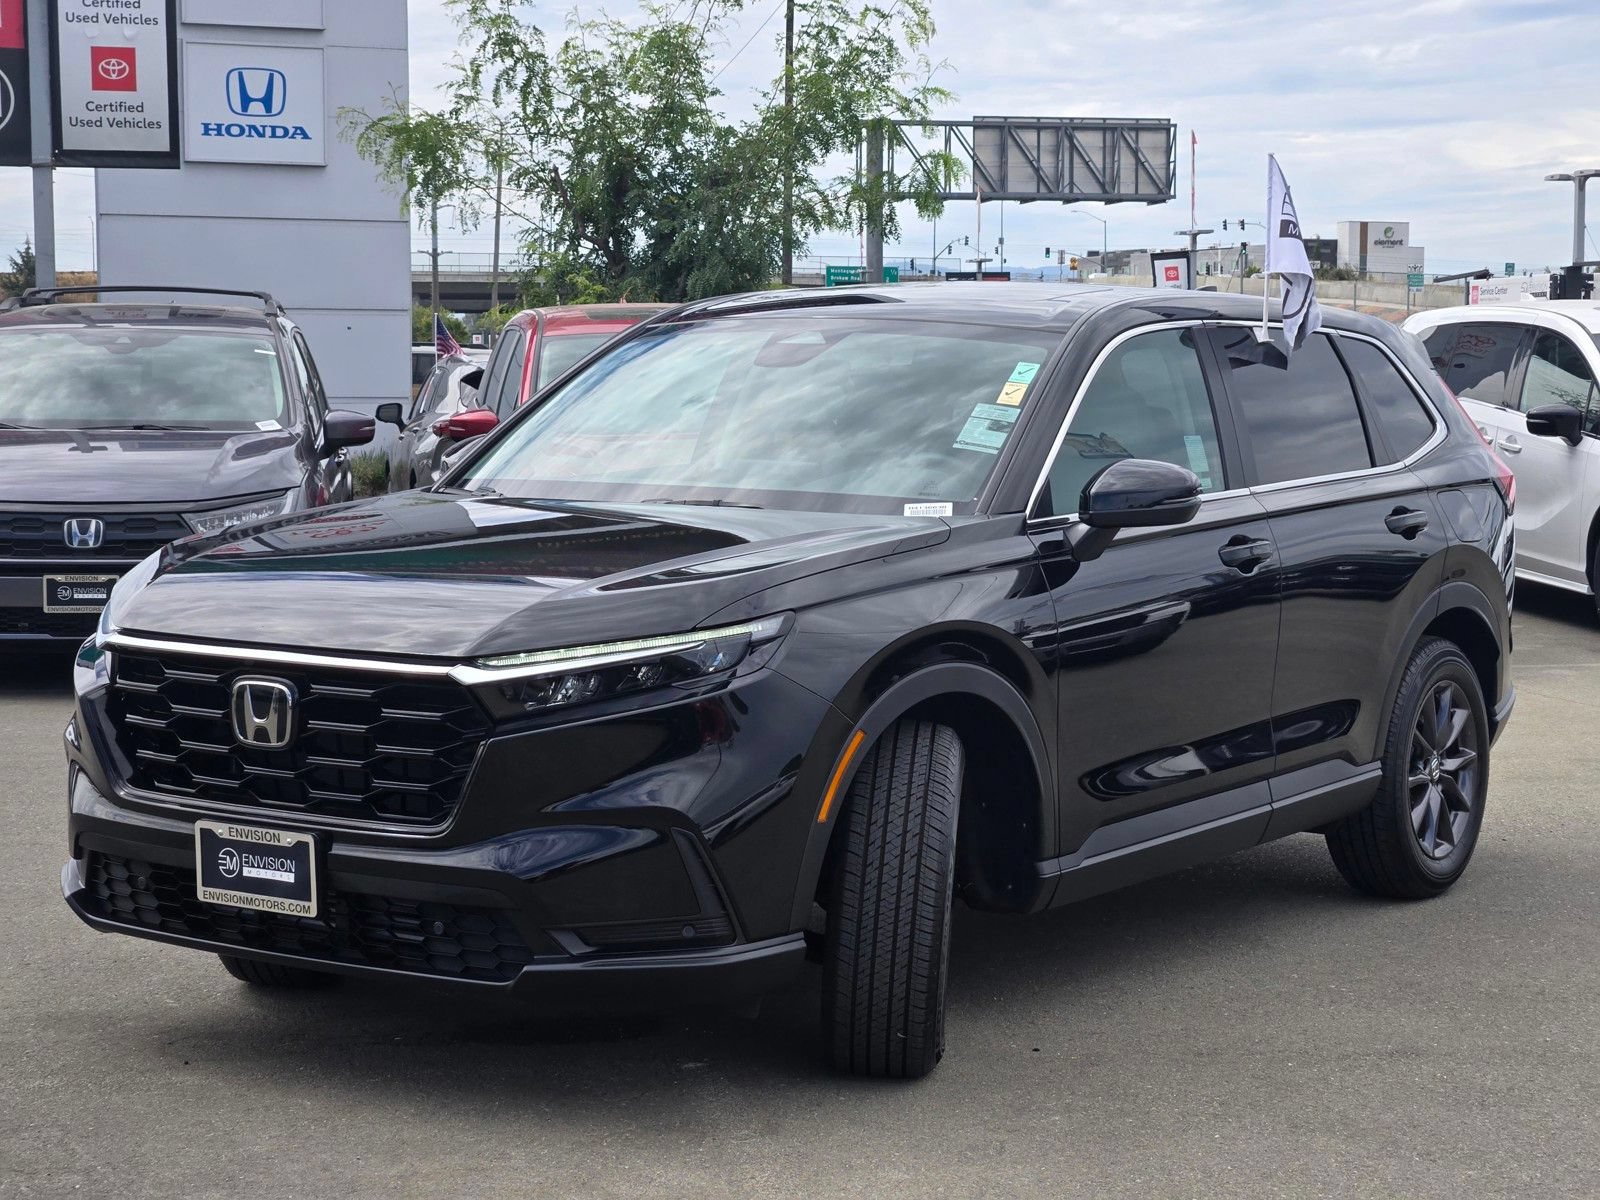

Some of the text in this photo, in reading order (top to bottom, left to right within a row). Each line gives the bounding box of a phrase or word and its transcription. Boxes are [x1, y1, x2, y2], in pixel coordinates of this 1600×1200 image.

[65, 12, 159, 25] Used Vehicles
[85, 101, 144, 113] Certified
[69, 116, 162, 129] Used Vehicles
[200, 122, 312, 140] HONDA
[1374, 237, 1404, 246] element
[228, 826, 281, 843] ENVISION
[242, 853, 295, 872] ENVISION
[247, 869, 291, 881] MOTORS
[202, 890, 311, 915] ENVISIONMOTORS.COM
